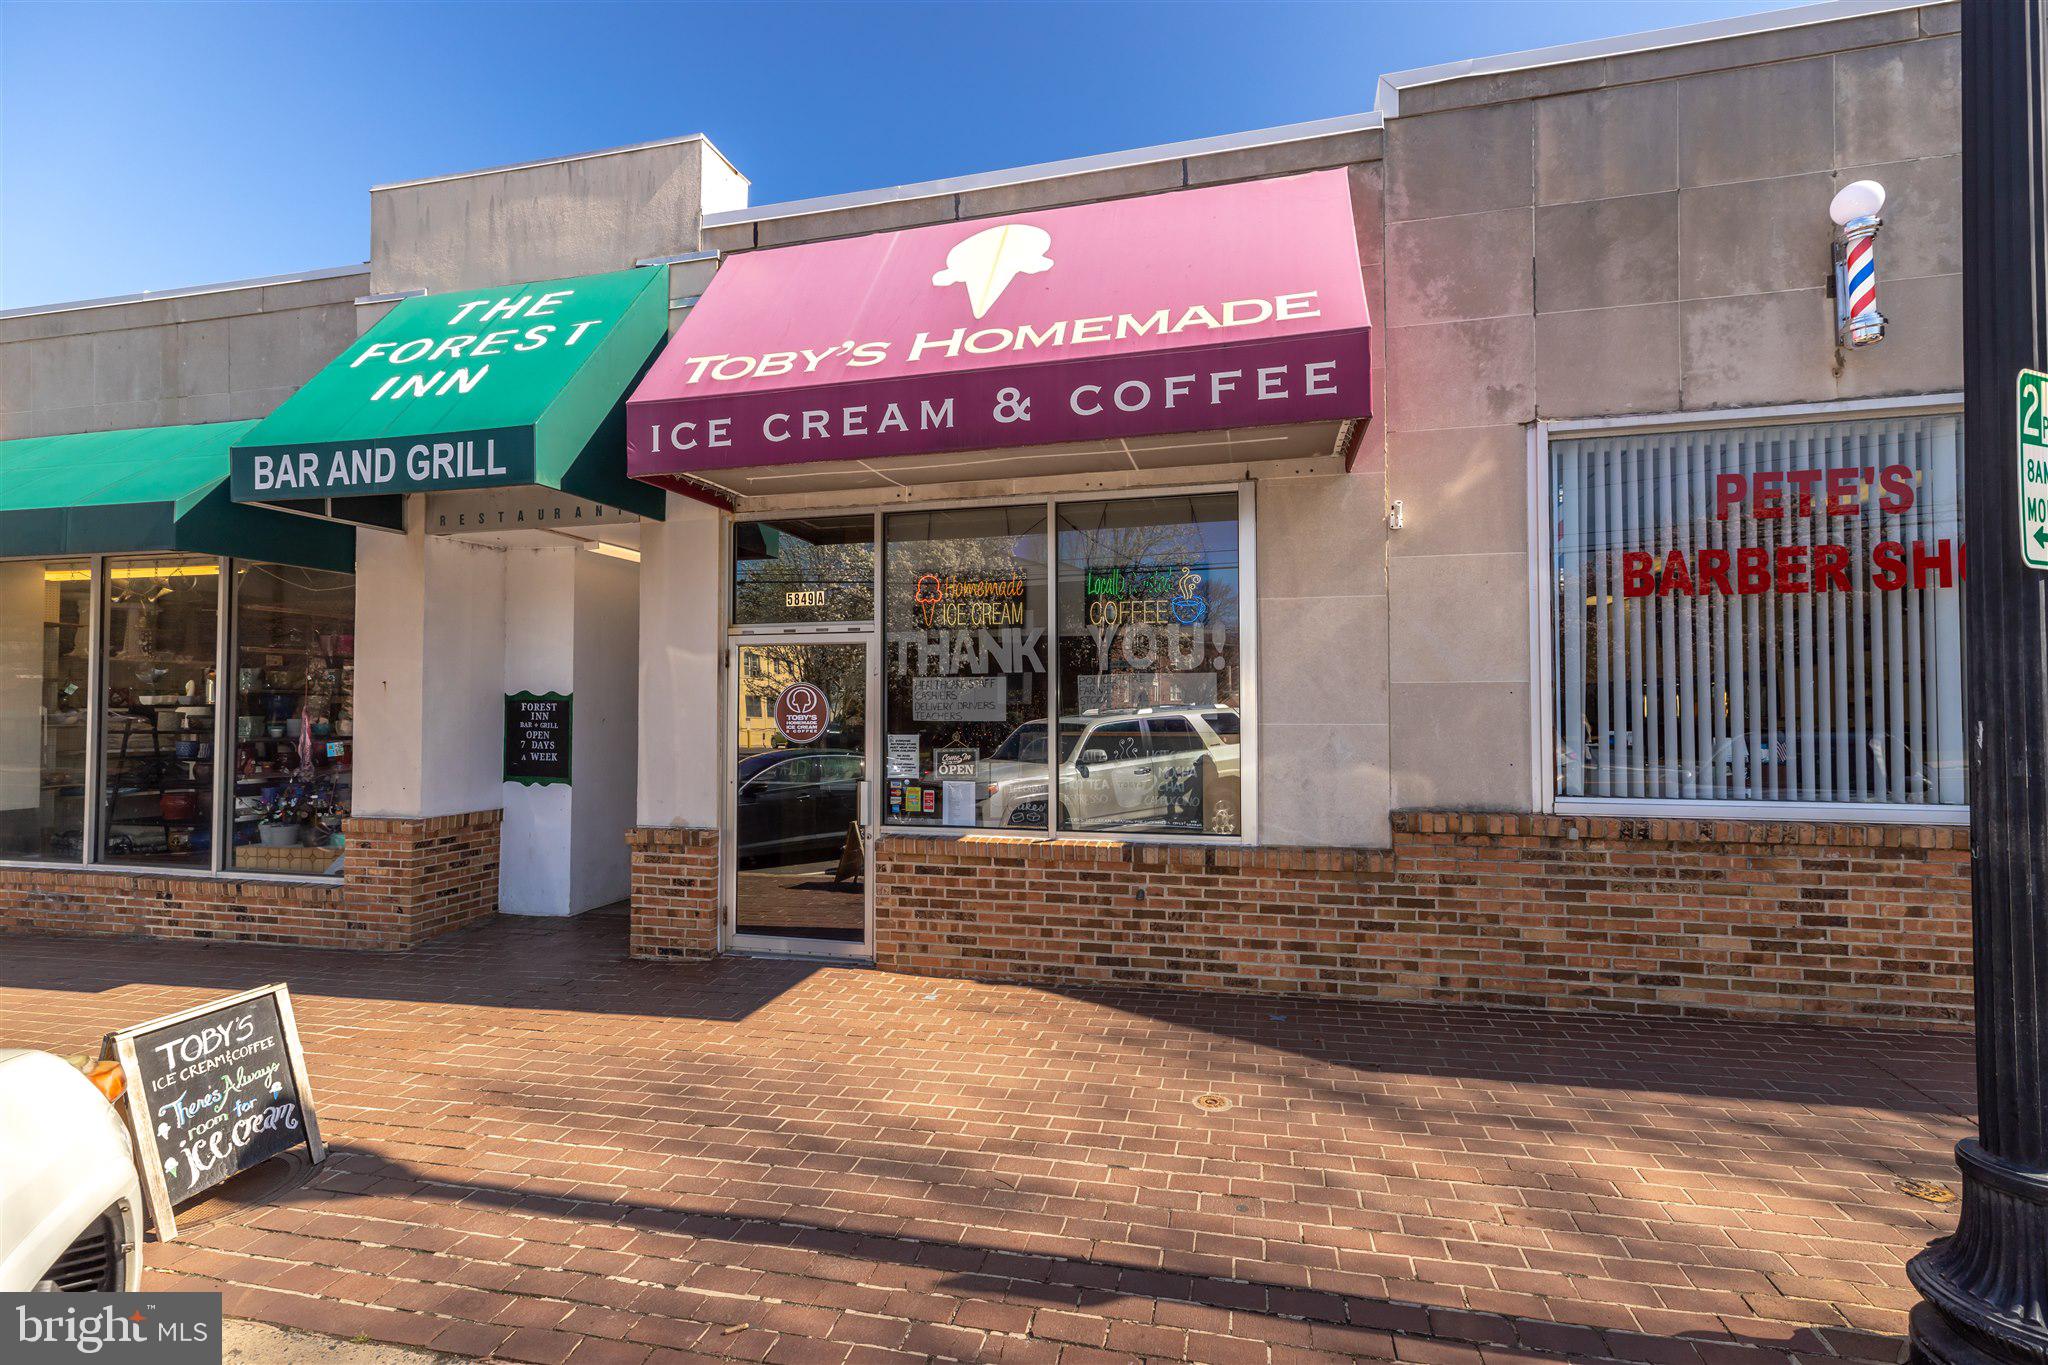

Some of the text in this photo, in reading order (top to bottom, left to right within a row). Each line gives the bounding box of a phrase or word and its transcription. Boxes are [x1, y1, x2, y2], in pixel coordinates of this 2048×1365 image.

[448, 290, 574, 325] THE
[350, 320, 602, 368] FOREST
[684, 290, 1321, 384] TOBY'S HOMEMADE
[371, 364, 488, 401] INN
[651, 359, 1338, 453] ICE CREAM & COFFEE
[254, 439, 507, 490] BAR AND GRILL
[1716, 464, 1915, 521] PETE'S
[2027, 497, 2048, 523] MO
[1622, 538, 1967, 598] BARBER SH
[945, 573, 1024, 598] Homemade
[943, 602, 1023, 625] ICE CREAM
[1090, 600, 1168, 625] COFFEE
[886, 628, 1046, 674] THANK
[1086, 622, 1227, 672] YOU!
[914, 679, 965, 690] HEATHCARE
[521, 702, 558, 711] FOREST
[531, 712, 549, 720] INN
[914, 701, 996, 711] DELIVERY DRIVERS
[915, 711, 963, 720] TEACHERS
[526, 731, 550, 740] OPEN
[531, 741, 555, 749] DAYS
[530, 752, 558, 761] WEEK
[939, 764, 975, 775] OPEN
[941, 753, 972, 762] Come In
[154, 1015, 254, 1072] TOBY'S
[152, 1072, 177, 1092] ICE
[158, 1062, 280, 1128] There's Always
[187, 1097, 258, 1141] room for
[179, 1103, 299, 1189] ice cream
